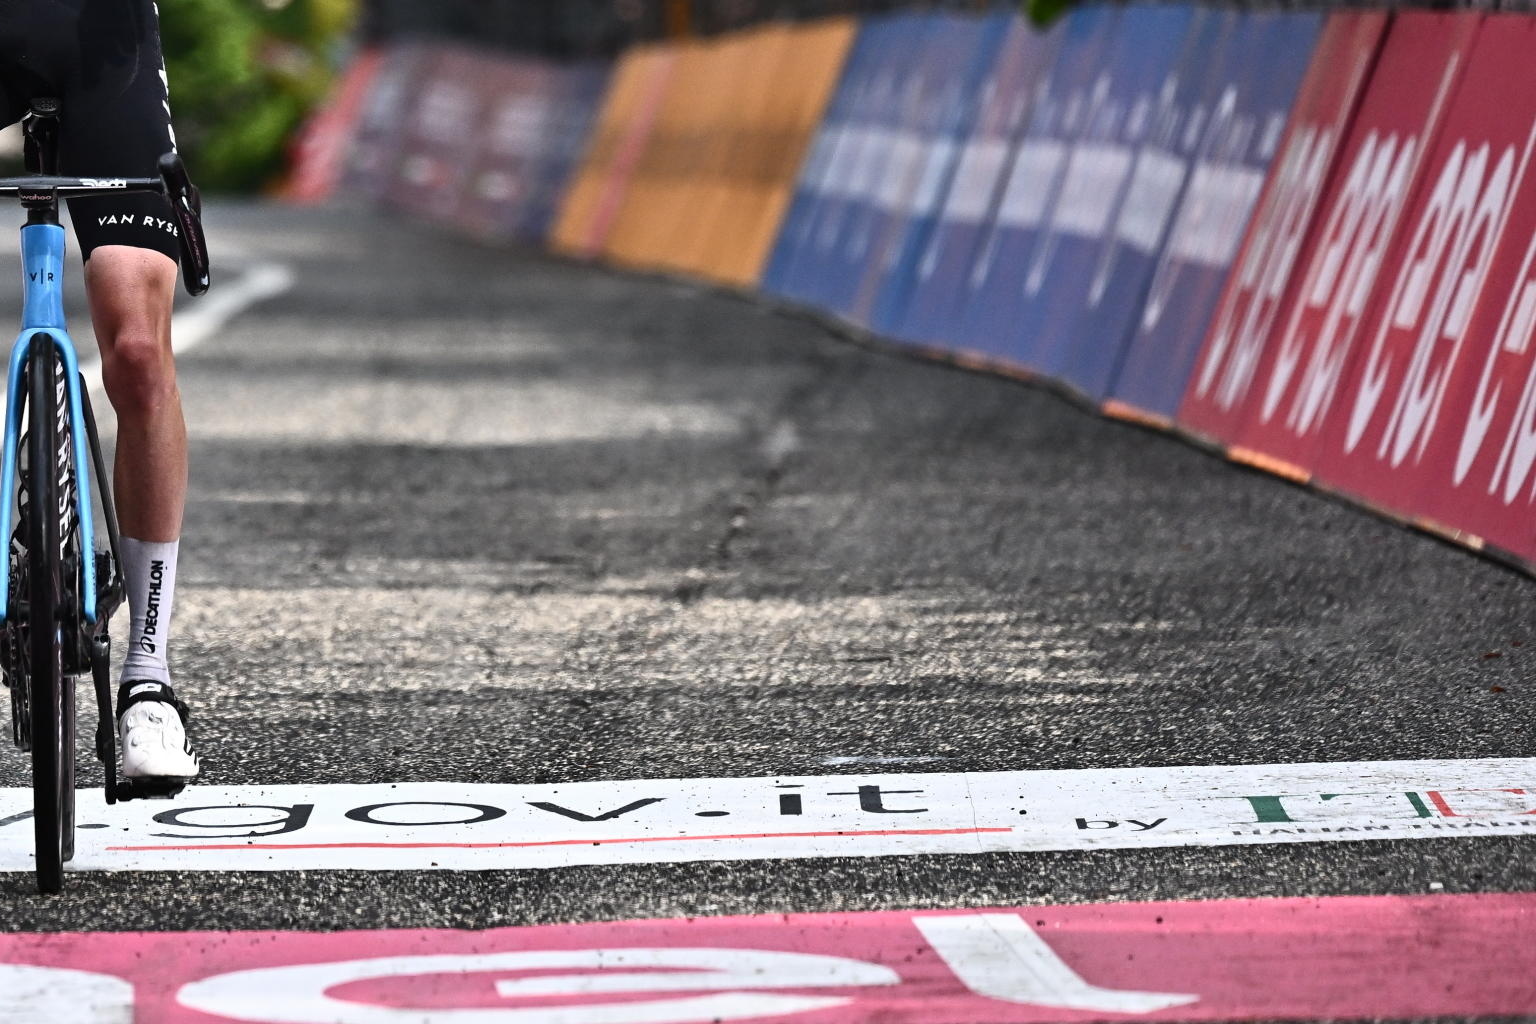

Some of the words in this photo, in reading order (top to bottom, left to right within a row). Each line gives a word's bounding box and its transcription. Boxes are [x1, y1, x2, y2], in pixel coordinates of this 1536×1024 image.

[98, 214, 134, 226] VAN
[144, 560, 163, 636] DECATHLON
[1074, 817, 1168, 832] by
